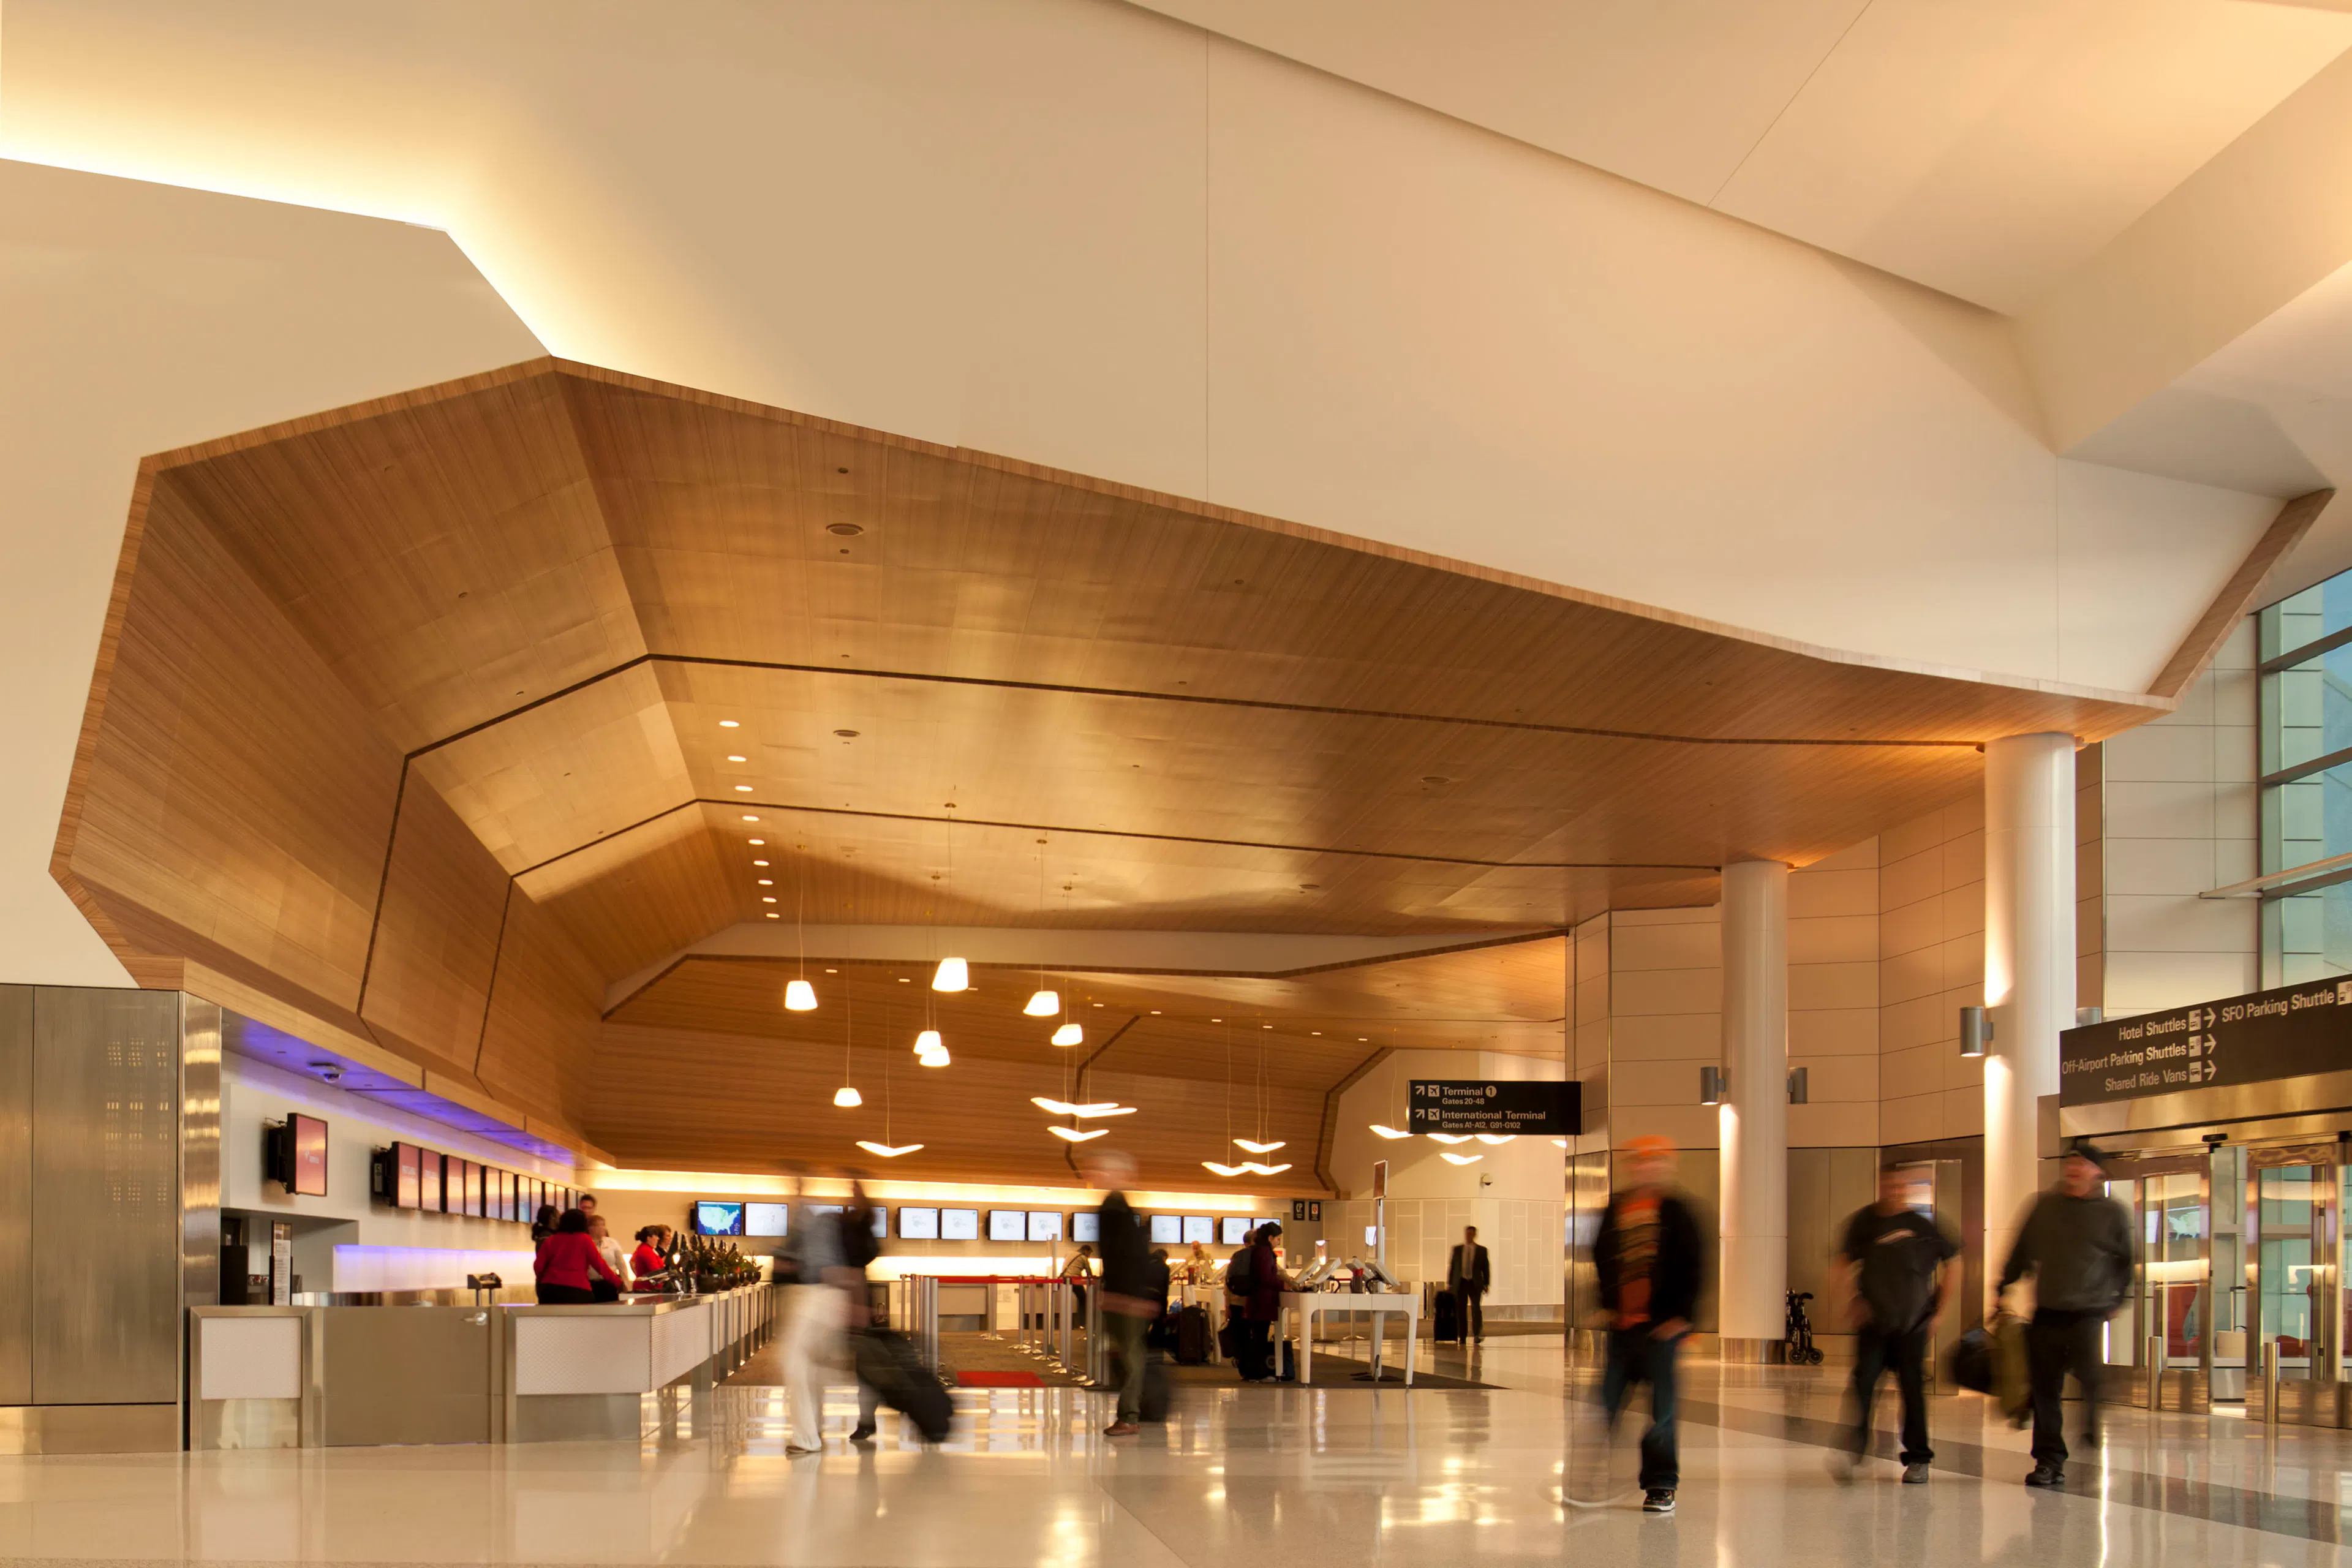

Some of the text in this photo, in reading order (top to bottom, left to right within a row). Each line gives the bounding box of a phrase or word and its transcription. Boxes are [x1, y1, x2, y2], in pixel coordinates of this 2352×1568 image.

[2222, 989, 2335, 1022] SFO Parking Shuttle
[2119, 1017, 2187, 1041] Hotel Shuttles
[2062, 1043, 2187, 1074] Off-Airport Parking Shuttles
[1442, 1087, 1483, 1096] Terminal
[2105, 1069, 2187, 1091] Shared Ride Vans
[1442, 1110, 1546, 1120] International Terminal
